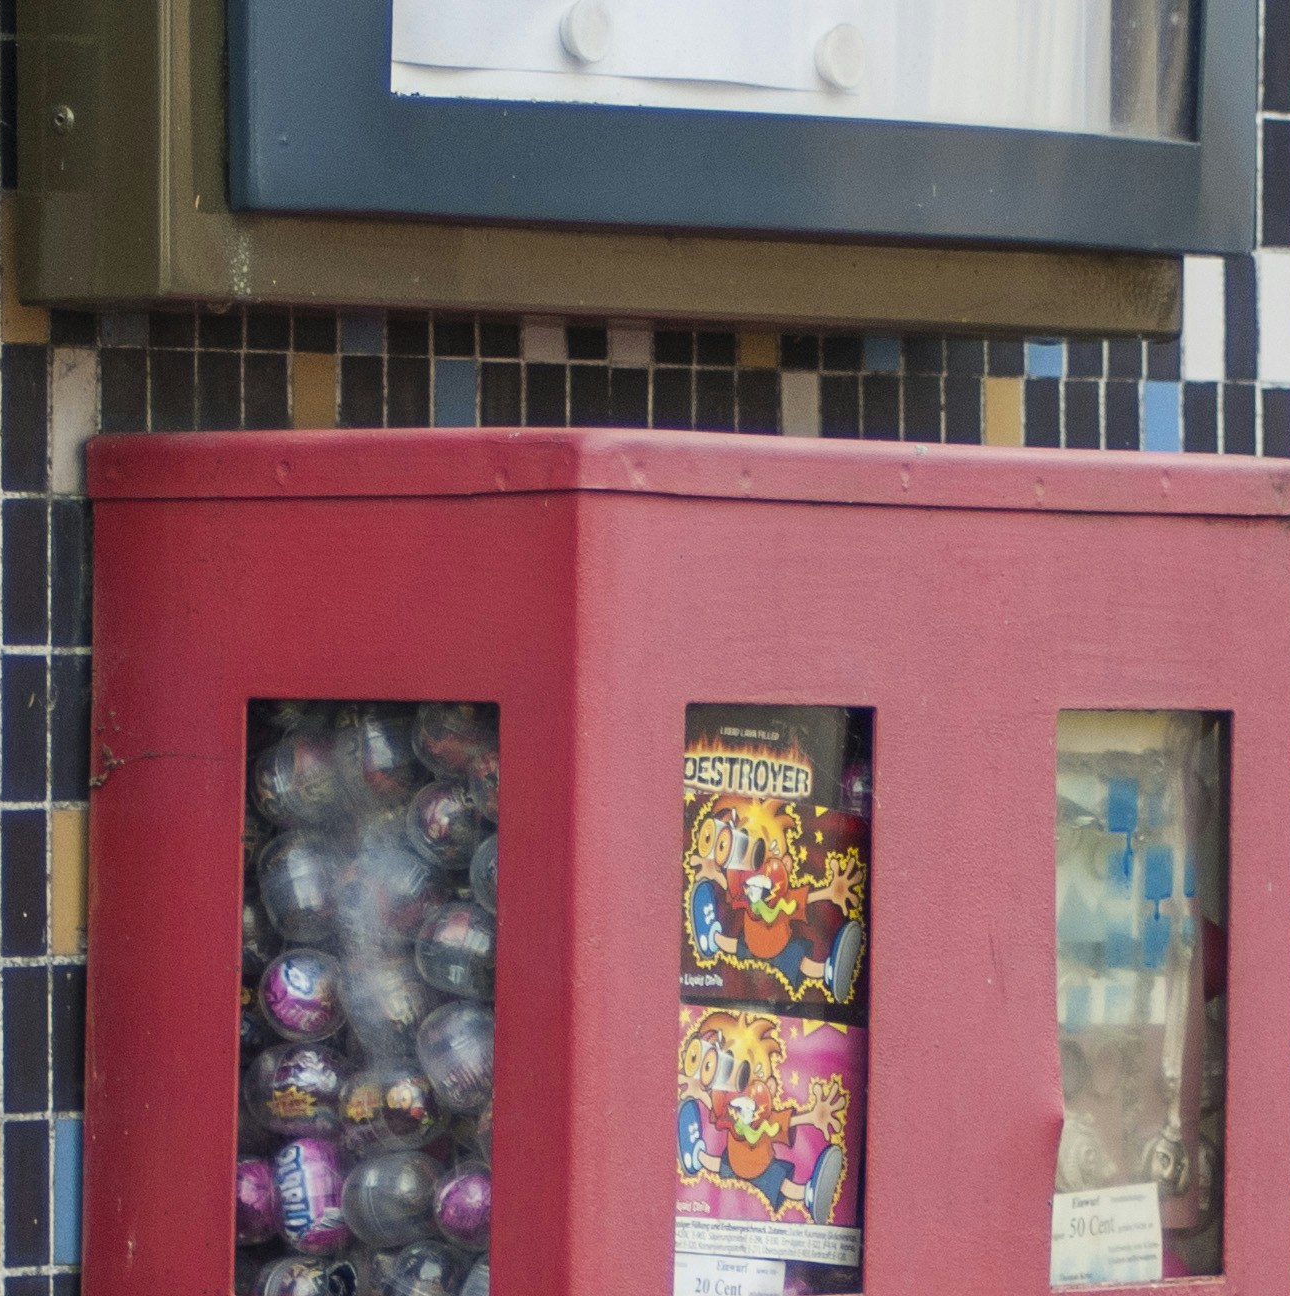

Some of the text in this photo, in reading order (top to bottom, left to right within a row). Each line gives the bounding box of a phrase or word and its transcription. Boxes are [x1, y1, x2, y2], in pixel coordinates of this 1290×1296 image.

[684, 756, 810, 793] DESTROYER
[1069, 1217, 1086, 1239] 50
[1089, 1215, 1115, 1236] Cent
[716, 1260, 748, 1274] Einwurf
[694, 1277, 742, 1296] 20 Cent
